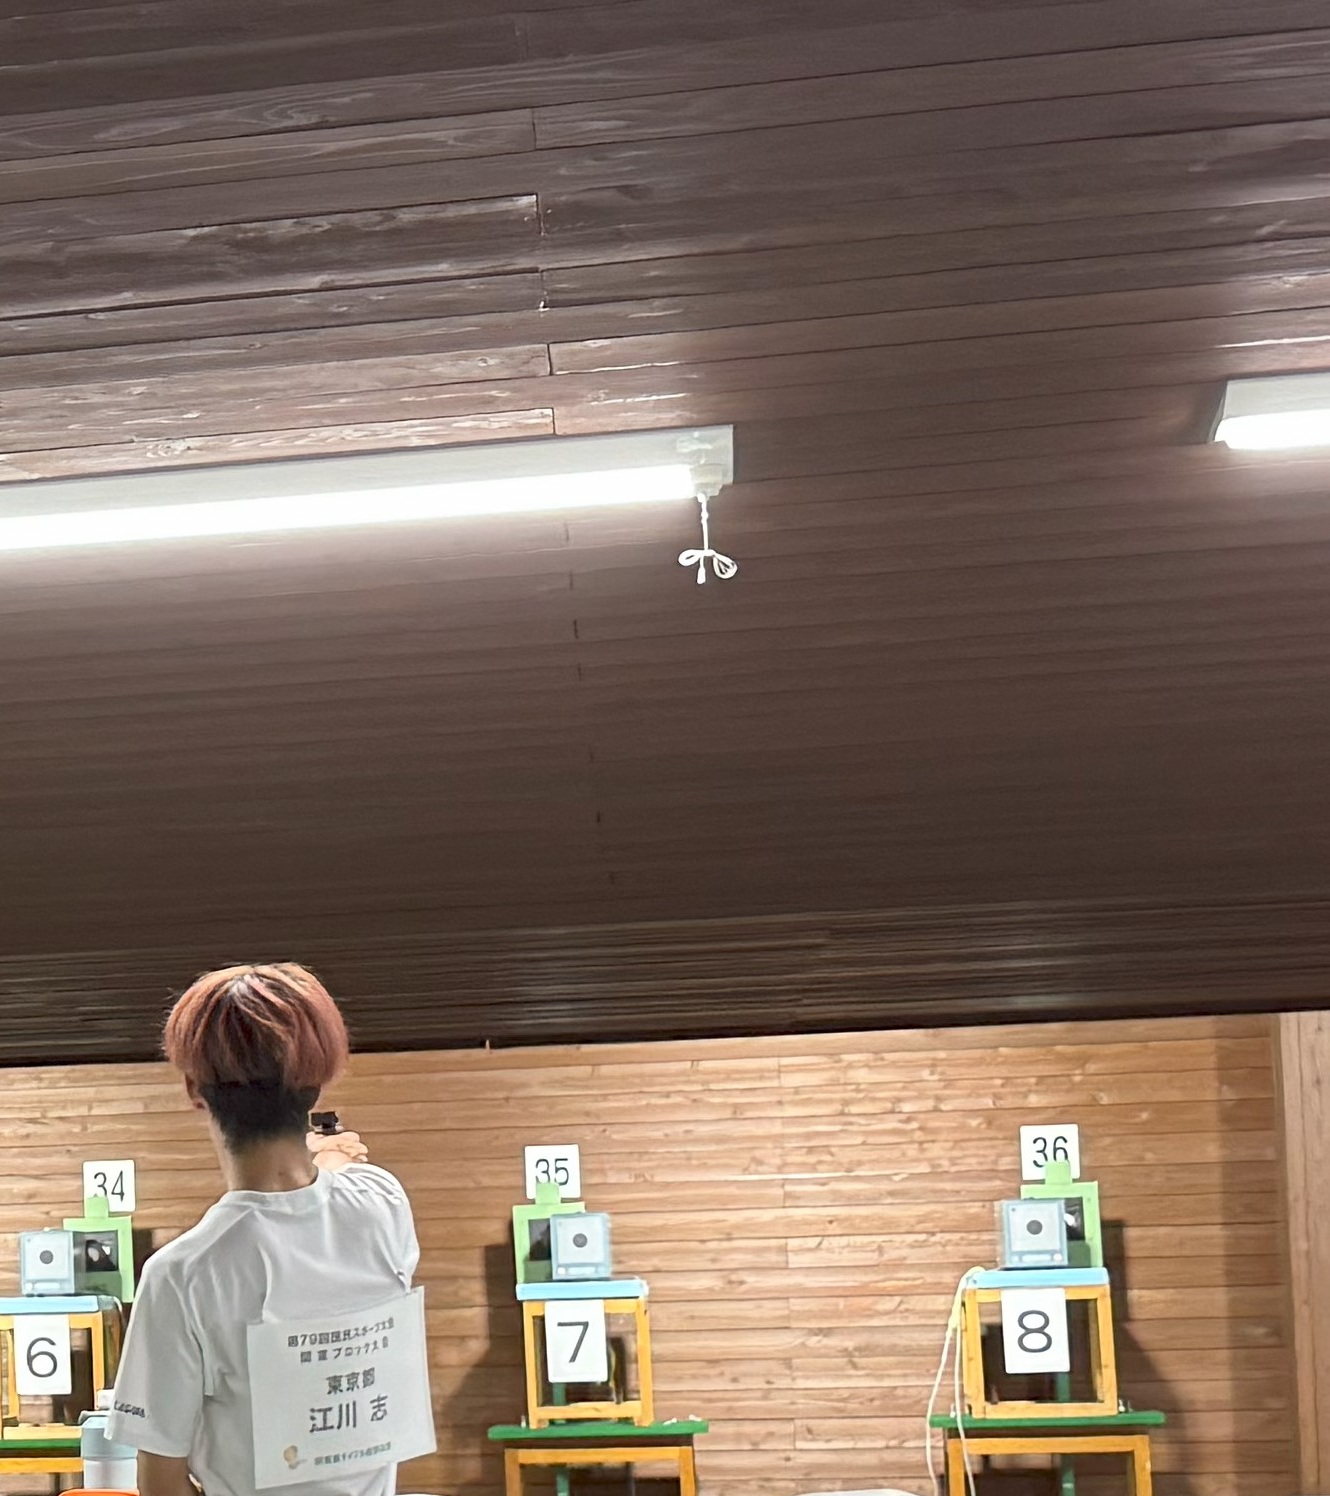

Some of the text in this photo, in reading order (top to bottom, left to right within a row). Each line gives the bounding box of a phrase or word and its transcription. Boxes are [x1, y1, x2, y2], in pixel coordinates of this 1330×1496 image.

[1032, 1136, 1069, 1168] 36
[93, 1170, 125, 1202] 34
[535, 1158, 569, 1187] 35
[557, 1321, 589, 1363] 7
[1017, 1310, 1053, 1353] 8
[26, 1337, 58, 1378] 6
[326, 1367, 375, 1395] 東京都
[309, 1400, 357, 1433] 江川
